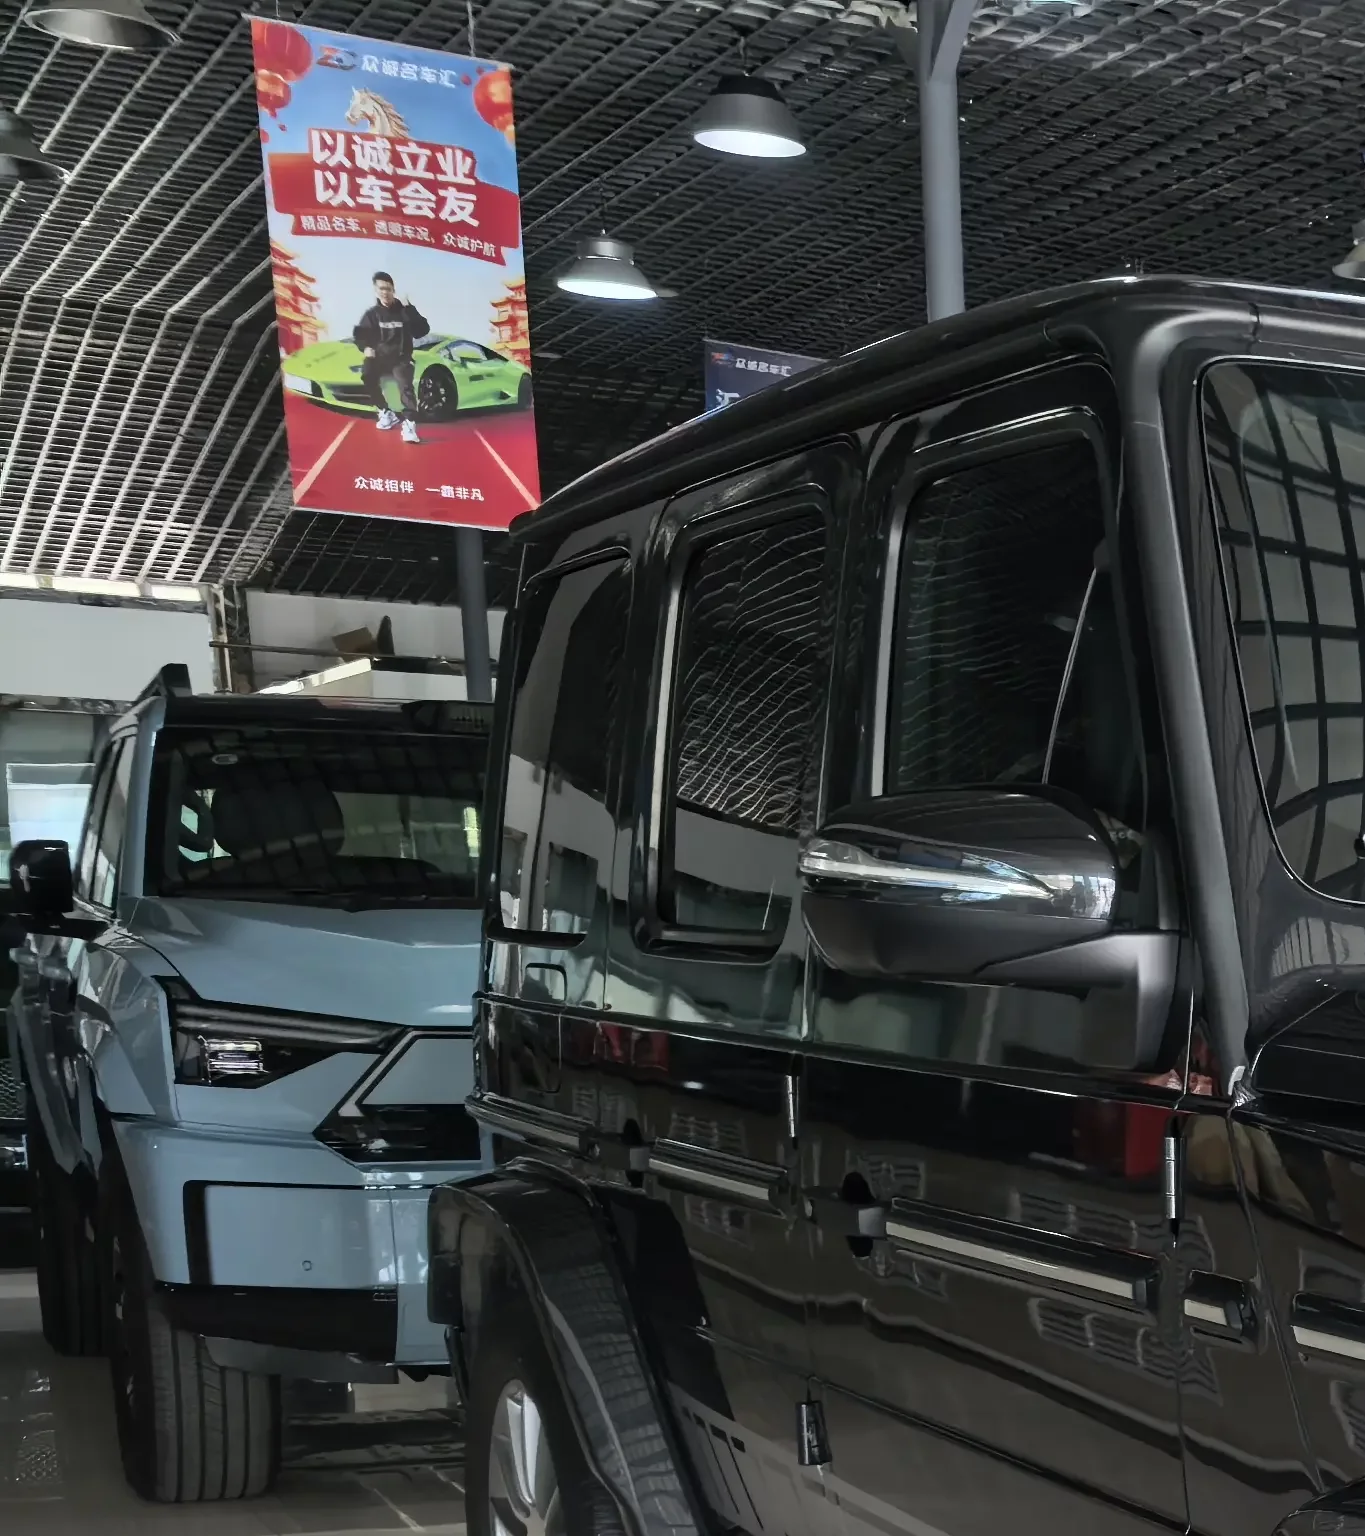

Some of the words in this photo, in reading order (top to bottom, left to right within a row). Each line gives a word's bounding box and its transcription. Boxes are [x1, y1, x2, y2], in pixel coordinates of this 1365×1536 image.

[311, 130, 476, 185] 以诚立业
[314, 169, 480, 227] 以车会友
